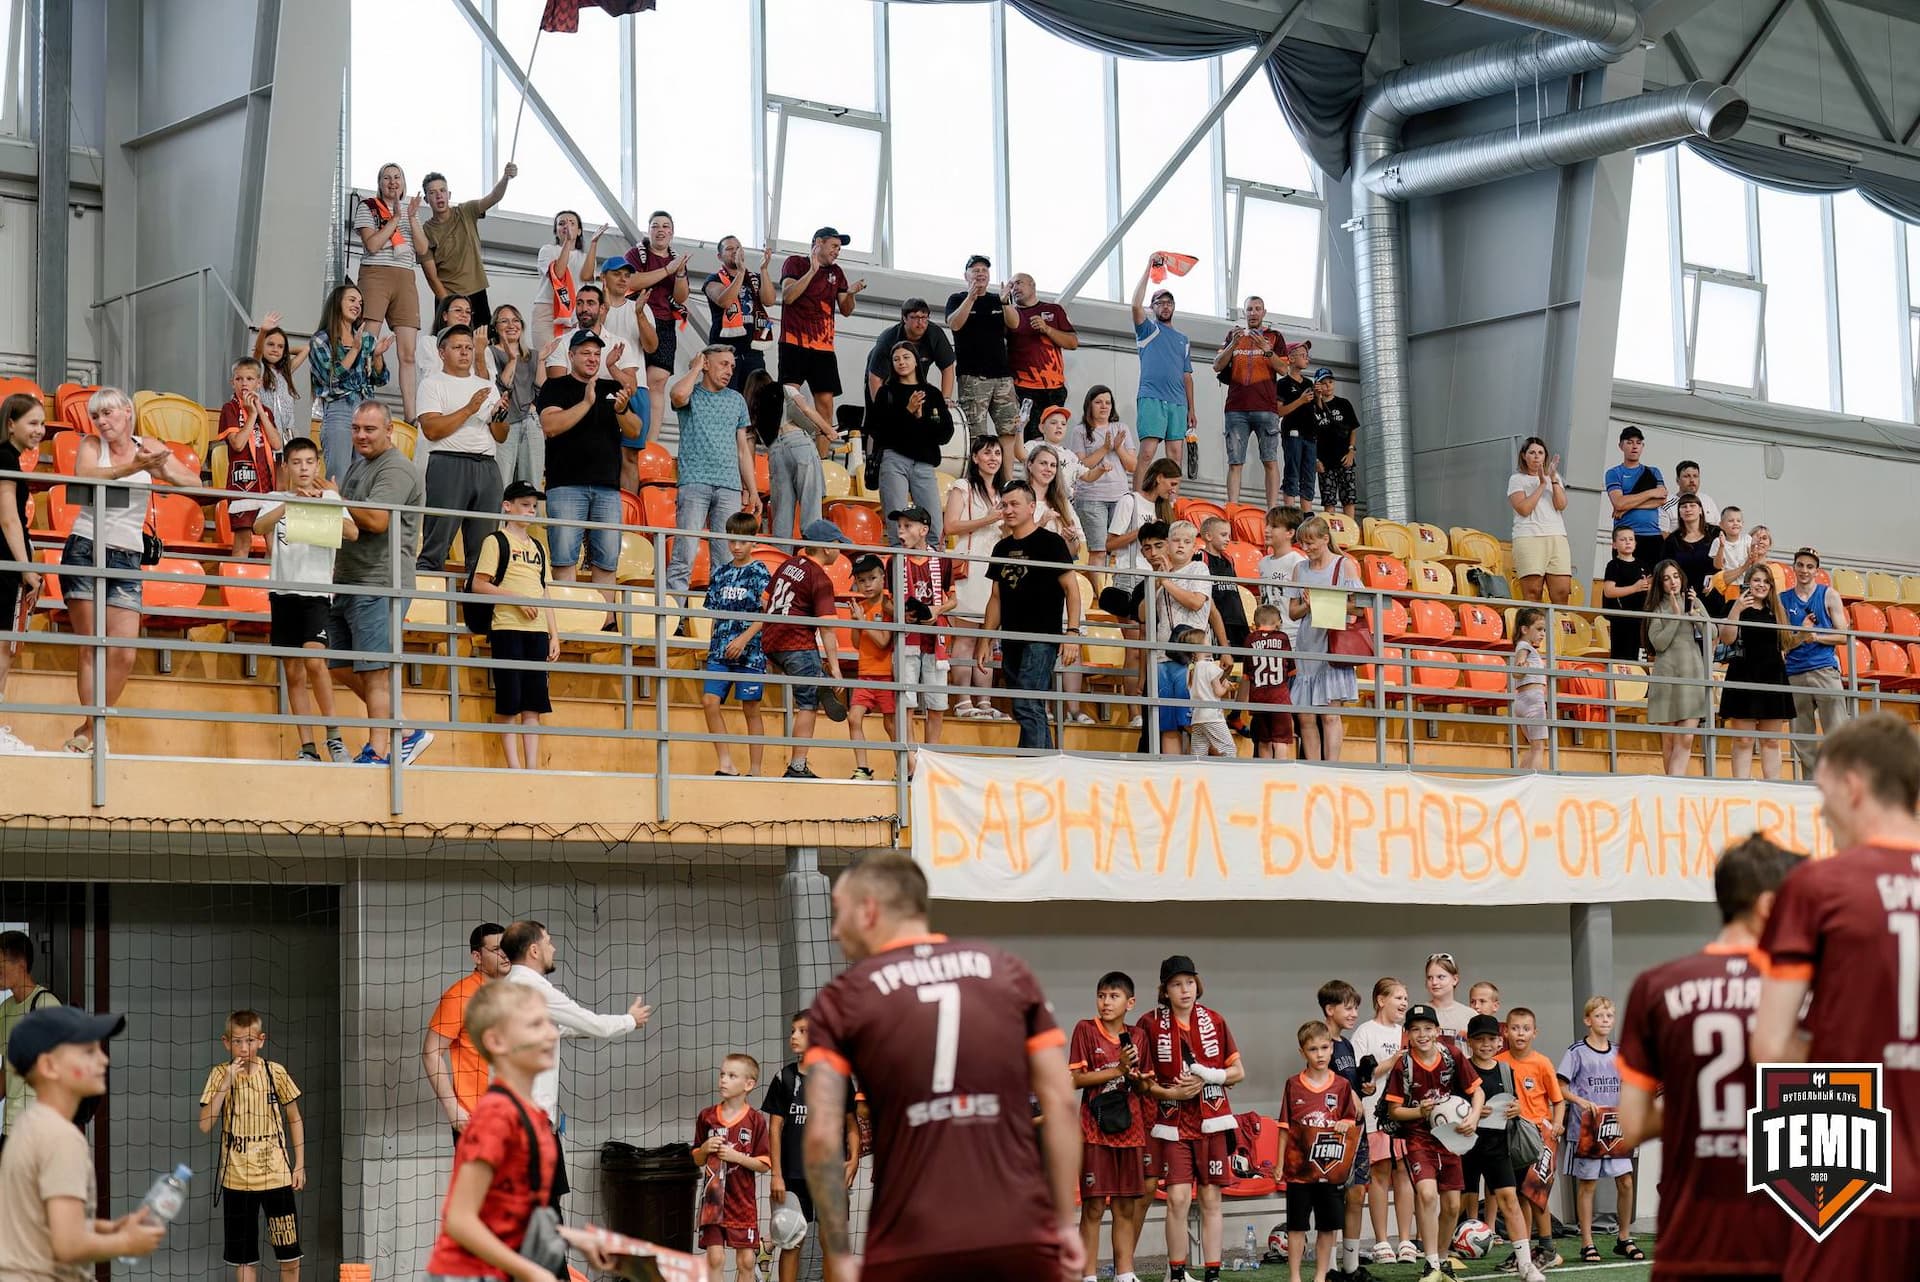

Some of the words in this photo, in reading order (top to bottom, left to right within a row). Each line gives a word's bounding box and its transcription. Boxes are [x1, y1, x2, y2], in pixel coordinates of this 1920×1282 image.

[512, 549, 541, 564] FILA
[1252, 656, 1284, 687] 29
[916, 982, 960, 1094] 7
[1315, 1144, 1342, 1159] ТЕМП
[1209, 1161, 1222, 1175] 32
